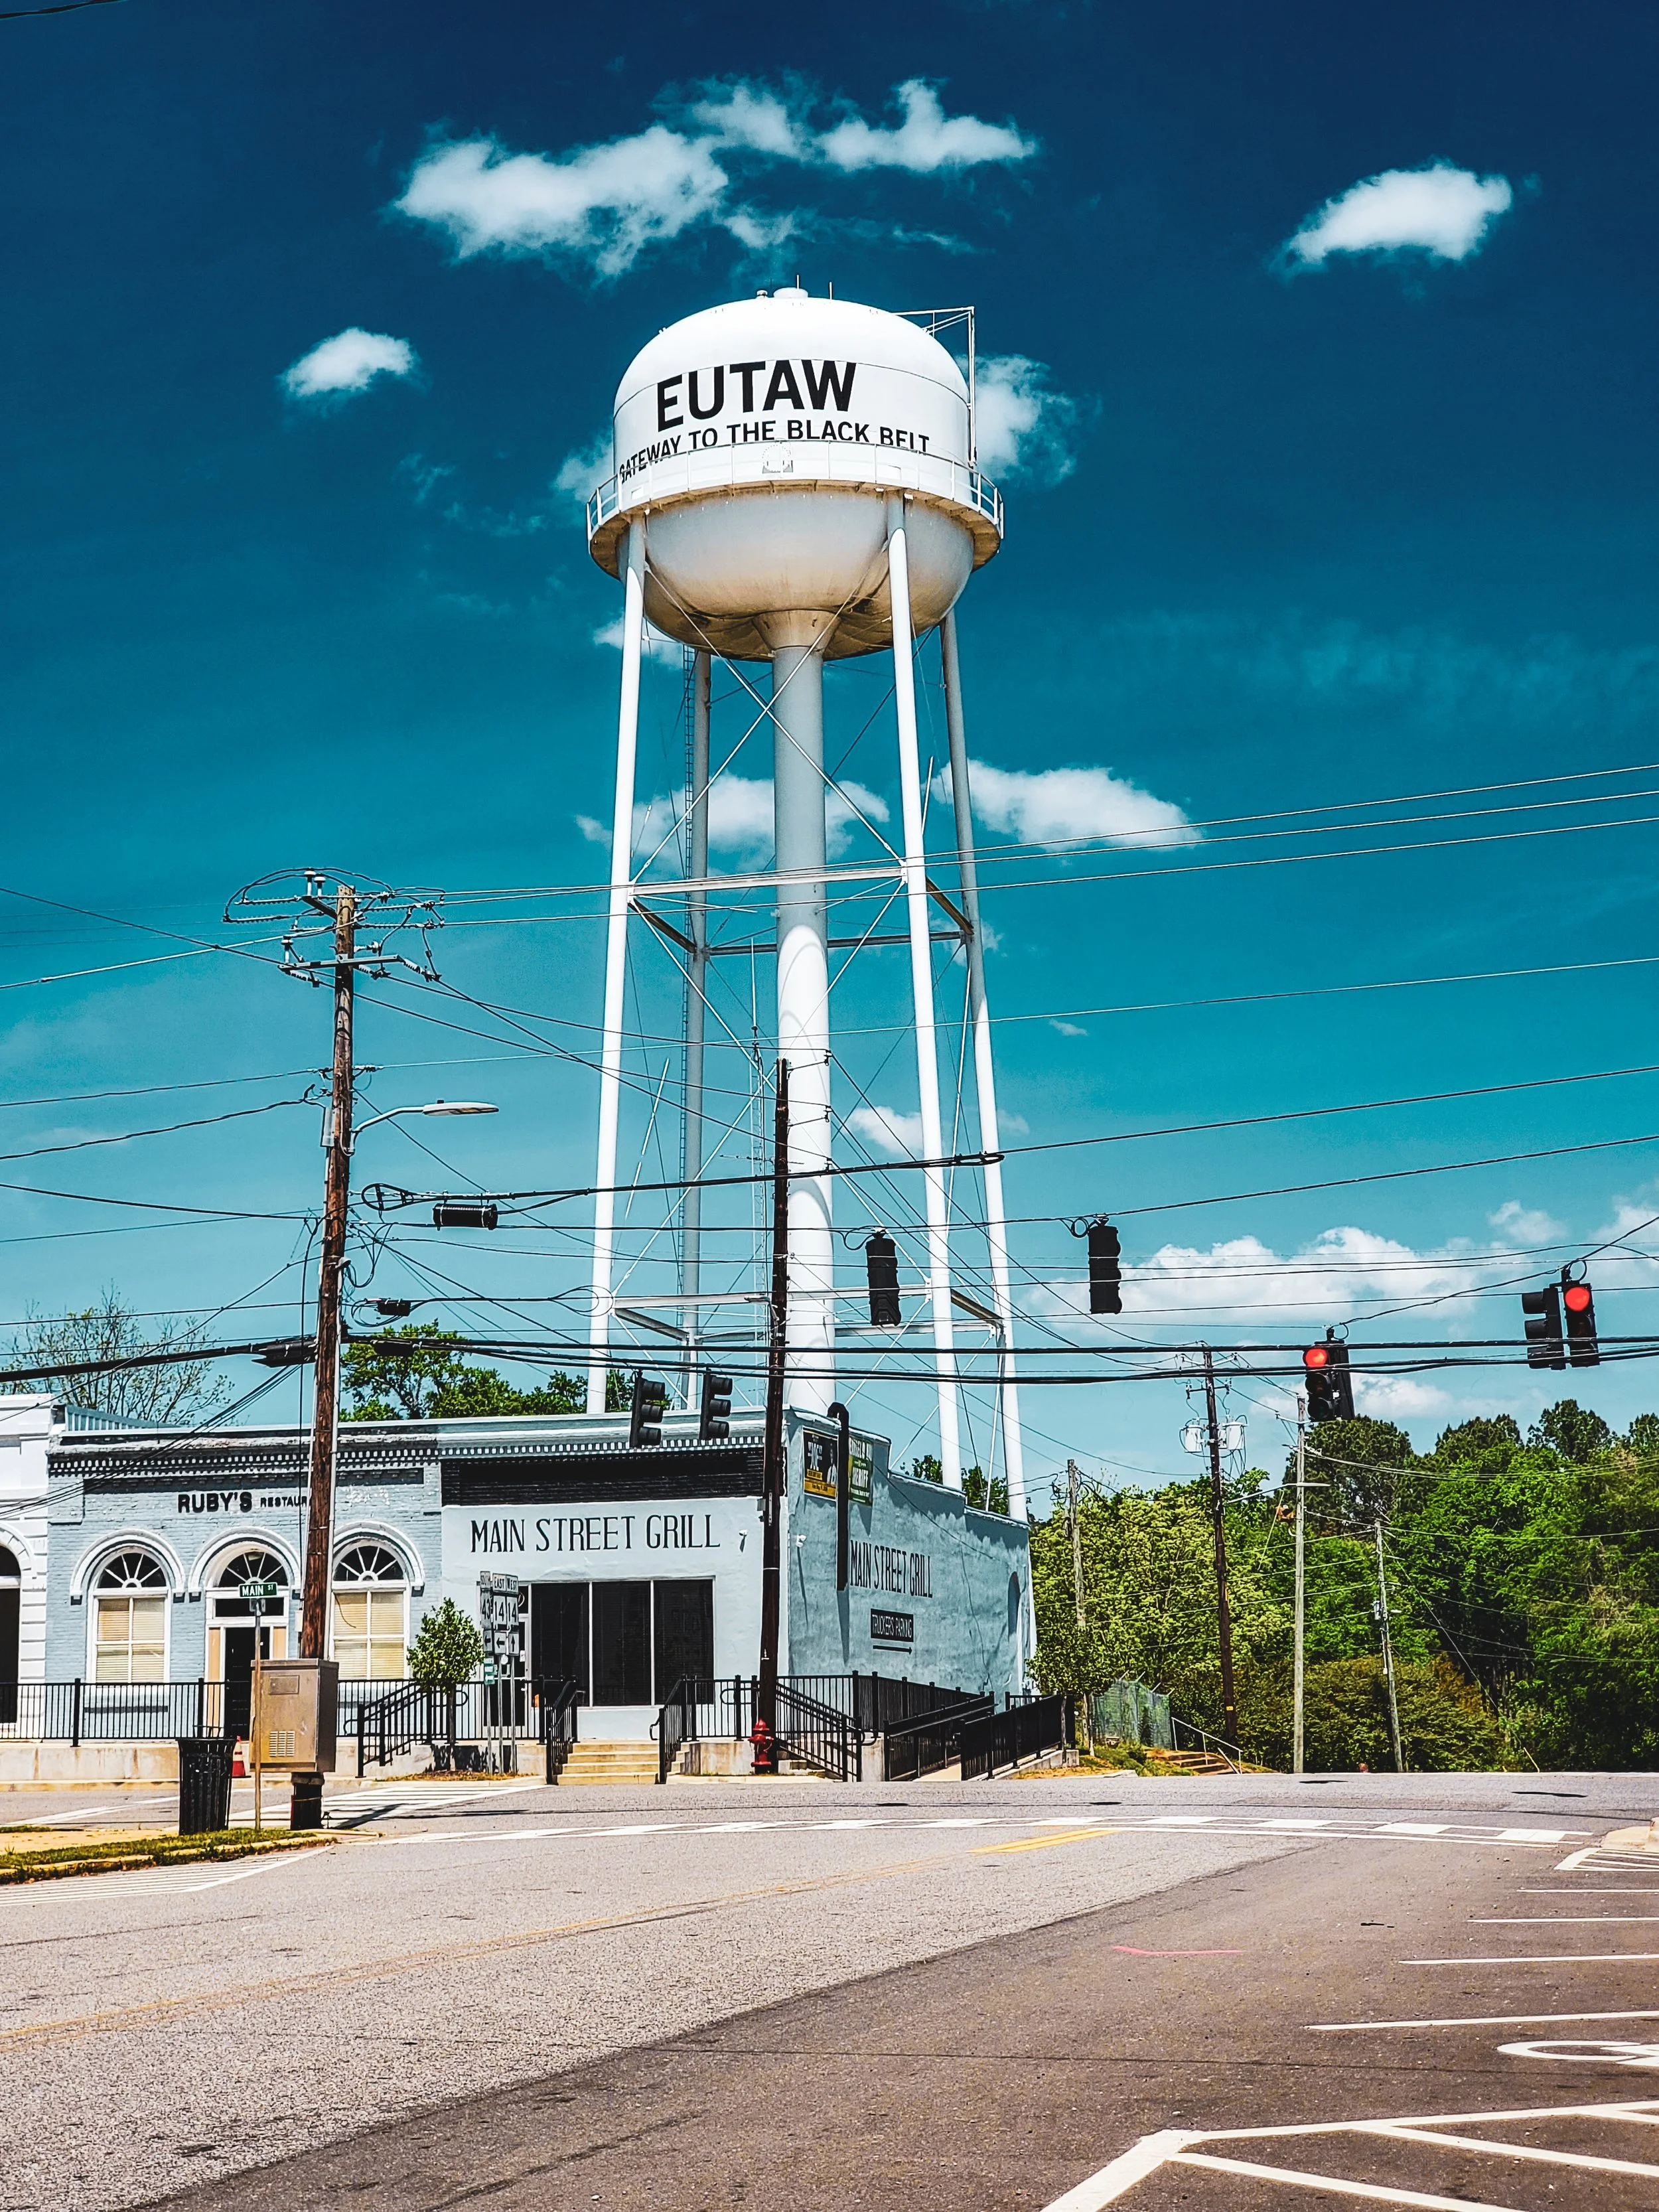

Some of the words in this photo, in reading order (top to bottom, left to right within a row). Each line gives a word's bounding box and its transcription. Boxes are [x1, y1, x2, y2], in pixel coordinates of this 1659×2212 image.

[656, 360, 857, 432] EUTAW
[619, 435, 682, 484] GATEWAY
[688, 428, 718, 449] TO
[726, 420, 776, 443] THE
[787, 419, 870, 443] BLACK
[178, 1492, 252, 1513] RUBY'S
[260, 1495, 308, 1508] RESTAUR
[470, 1518, 525, 1553] MAIN
[536, 1516, 636, 1552] STREET
[646, 1514, 721, 1549] GRILL
[850, 1540, 872, 1589] MAIN
[874, 1545, 907, 1593] STREET
[910, 1552, 933, 1598] GRILL
[242, 1585, 264, 1596] MAIN
[506, 1578, 517, 1591] WEST
[481, 1598, 491, 1620] 43
[494, 1601, 504, 1622] 14
[508, 1601, 517, 1623] 14
[871, 1613, 895, 1637] TRUCKERS
